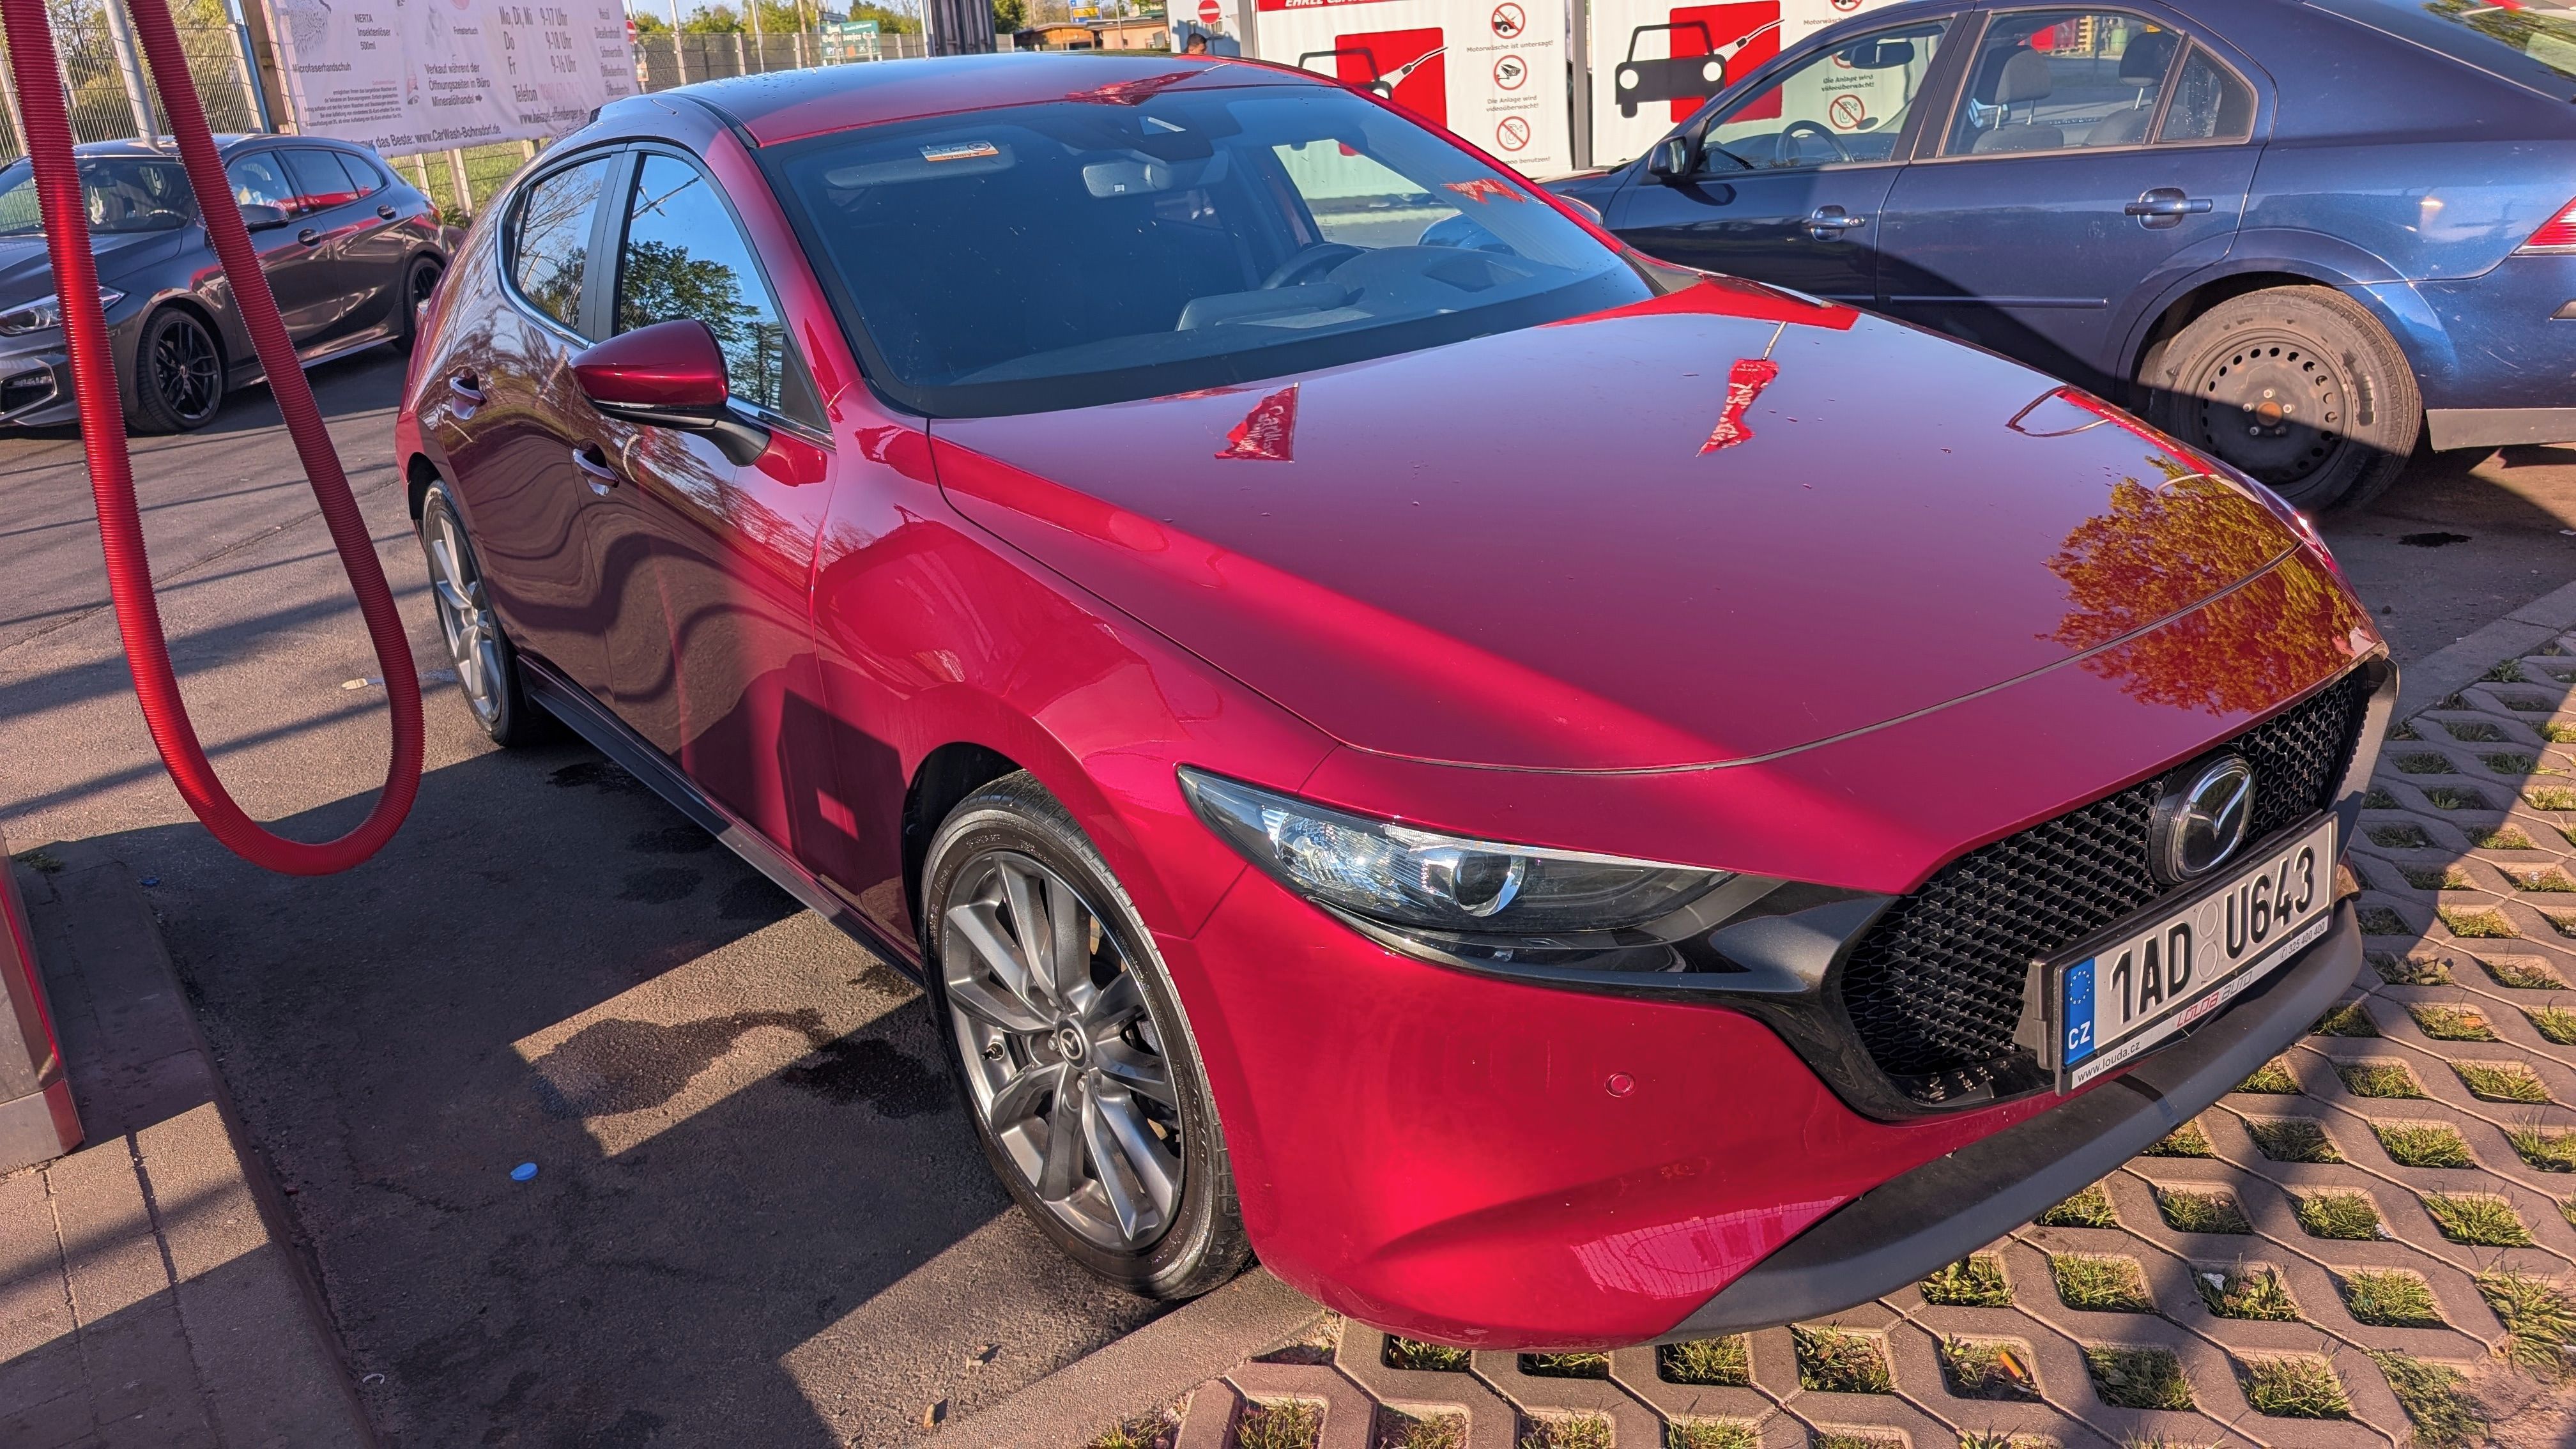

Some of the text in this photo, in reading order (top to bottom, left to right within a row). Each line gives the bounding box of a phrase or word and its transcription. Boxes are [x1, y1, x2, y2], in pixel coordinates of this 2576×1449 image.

[354, 14, 373, 23] NERTA
[499, 6, 568, 28] Mo, Di, Mi 9-17 Uhr
[1803, 16, 1844, 26] Motorwäsch
[357, 27, 390, 36] Insektenlöser
[360, 41, 376, 50] 500ml
[503, 31, 572, 50] Do 9-18 Uhr
[1466, 44, 1508, 52] Motorwäsche
[424, 63, 479, 74] Verkauf während der
[508, 55, 576, 75] Fr 9-16 Uhr
[429, 77, 470, 92] Öffnungszeiten
[476, 77, 490, 88] Büro
[1821, 82, 1874, 92] videoüberwacht!
[512, 84, 538, 102] Telefon
[1486, 103, 1539, 112] videoüberwacht!
[376, 136, 390, 148] das
[390, 133, 415, 147] Beste:
[415, 123, 501, 143] www.CarWash-Bohnsdorf.de
[2110, 844, 2315, 1025] 1AD U643
[2288, 921, 2325, 954] 325 400 400
[2067, 1020, 2090, 1050] CZ
[2078, 1041, 2140, 1082] www.louda.cz
